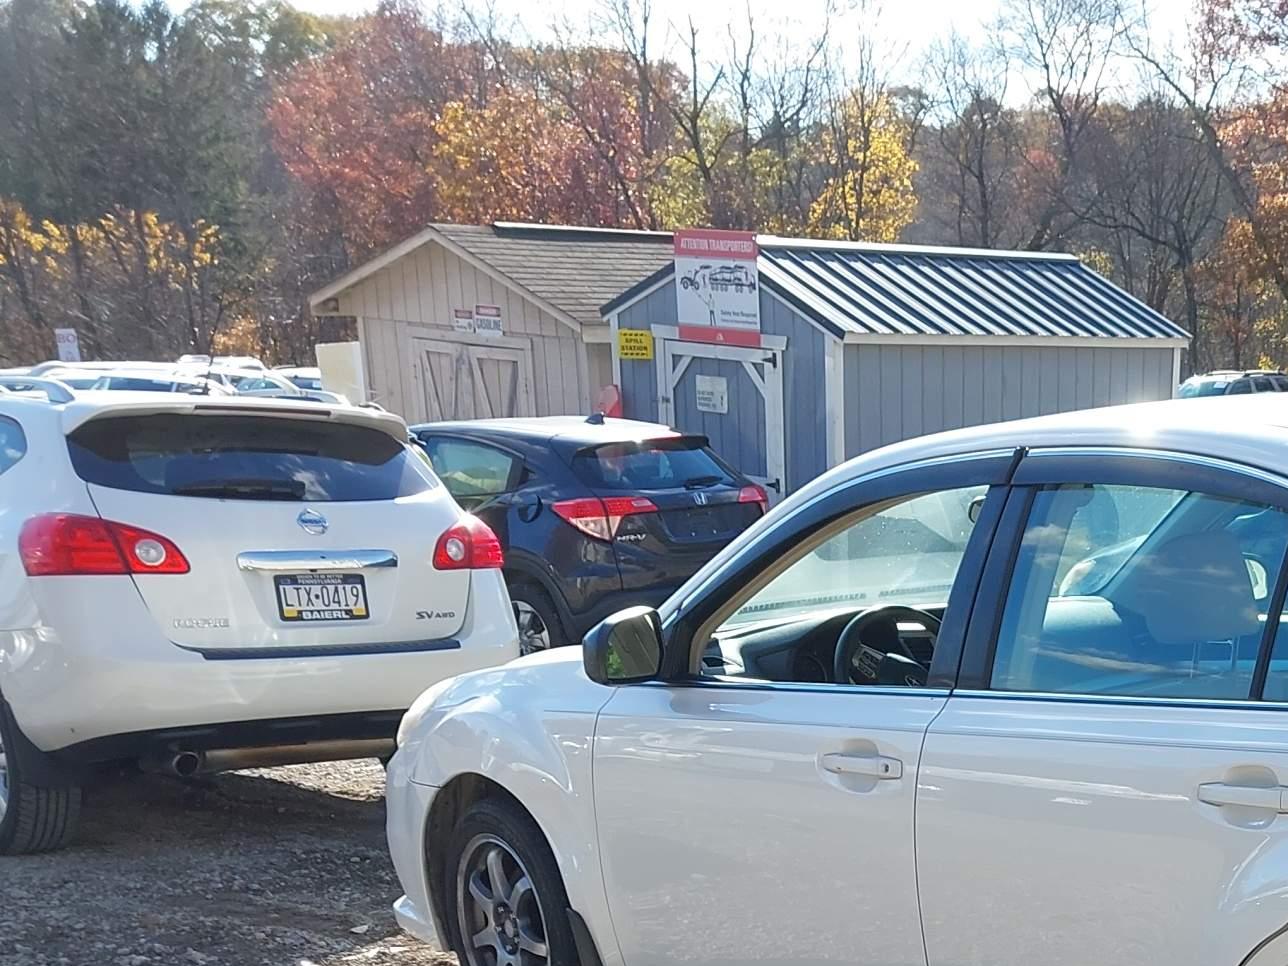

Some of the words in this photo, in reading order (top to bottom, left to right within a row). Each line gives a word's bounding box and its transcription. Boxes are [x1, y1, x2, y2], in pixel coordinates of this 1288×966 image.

[475, 317, 502, 331] GASOLINE
[621, 344, 649, 352] STATION
[302, 610, 351, 620] BAIERL
[415, 610, 434, 620] SV
